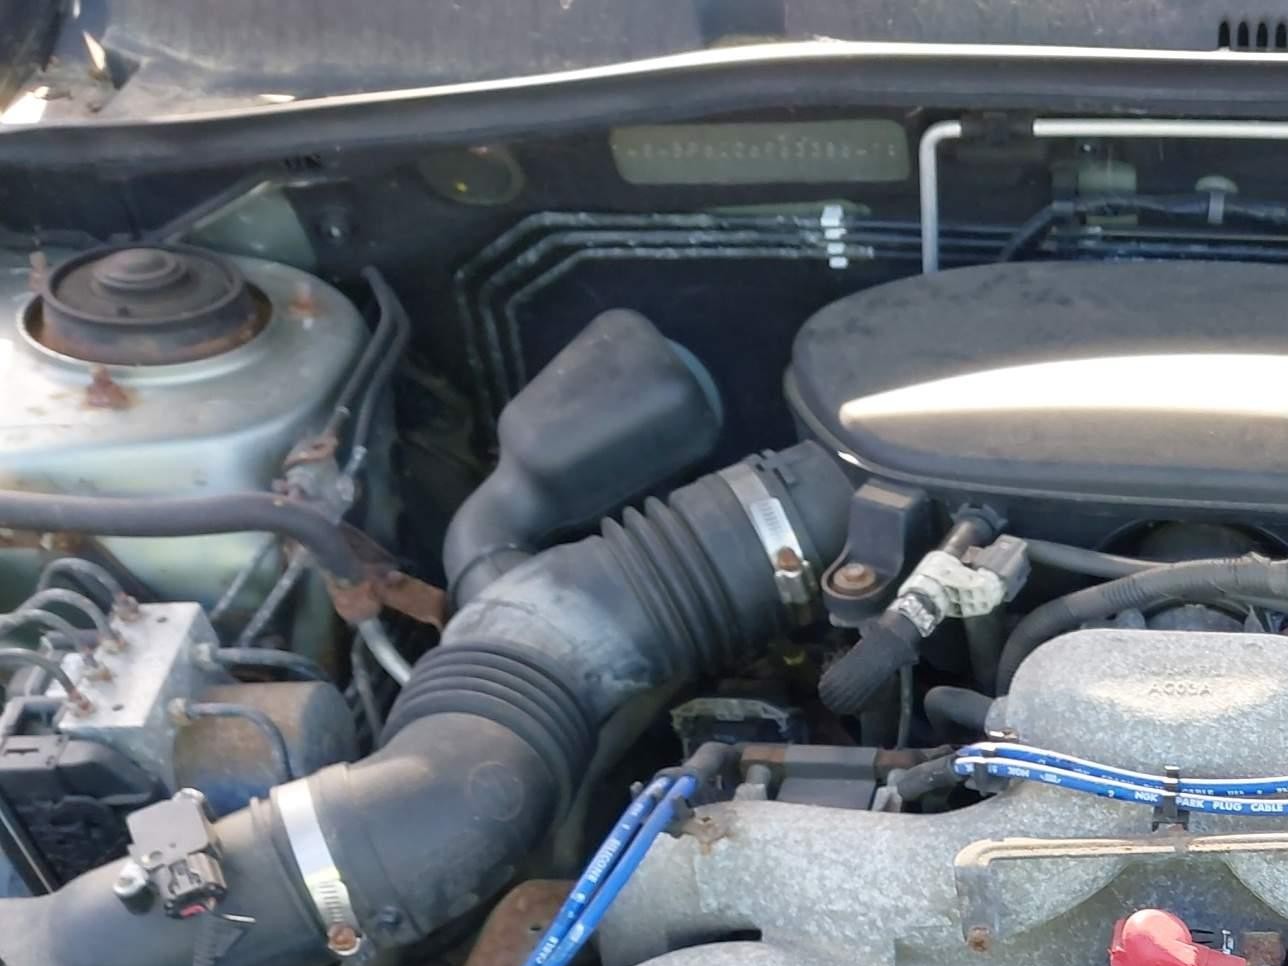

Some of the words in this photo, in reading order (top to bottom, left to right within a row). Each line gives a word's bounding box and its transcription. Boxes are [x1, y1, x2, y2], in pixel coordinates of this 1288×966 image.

[1134, 791, 1159, 803] NGK
[1175, 796, 1205, 809] PARK
[1213, 801, 1242, 812] PLUG
[1250, 803, 1284, 812] CABLE
